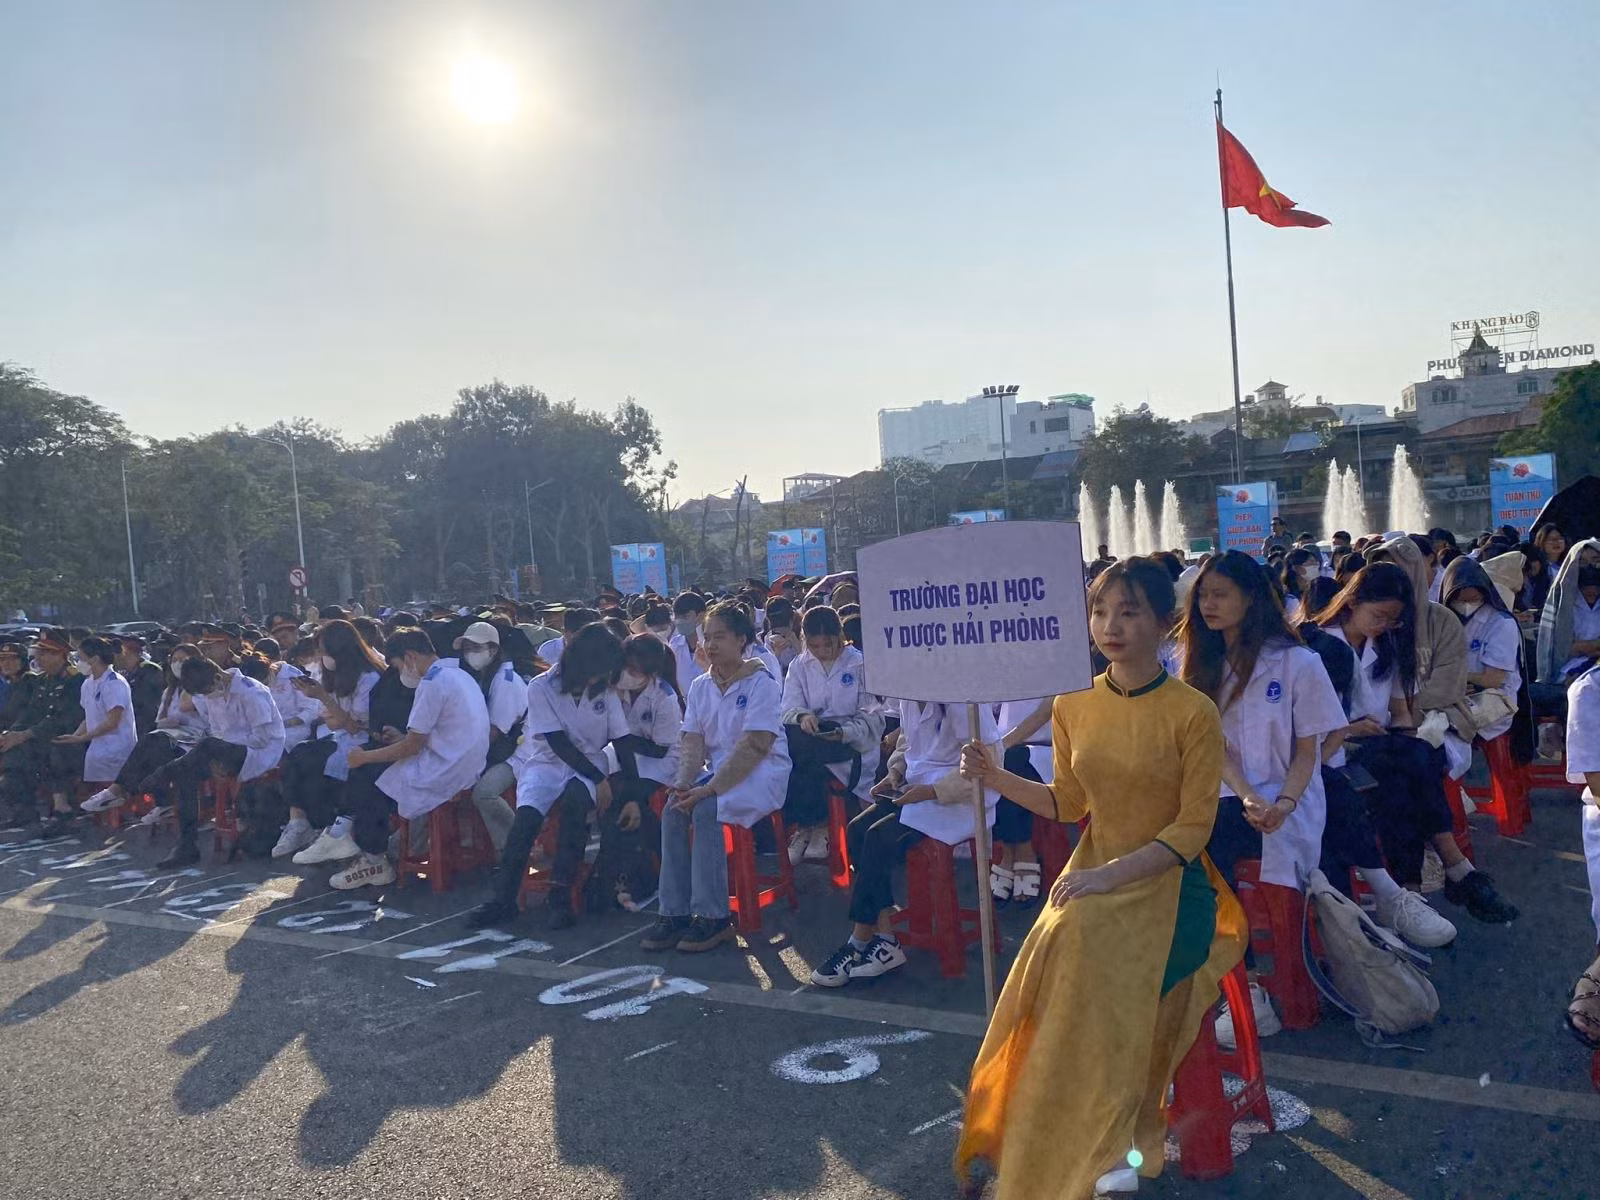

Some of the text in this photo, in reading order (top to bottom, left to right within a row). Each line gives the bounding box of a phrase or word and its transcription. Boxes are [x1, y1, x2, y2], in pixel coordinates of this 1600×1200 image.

[1452, 317, 1496, 331] KHANG
[1519, 343, 1595, 362] DIAMOND
[889, 576, 1046, 612] TRƯỜNG ĐẠI HỌC
[883, 611, 1061, 652] Y DƯỢC HẢI PHÒNG
[344, 864, 384, 884] BOSTON
